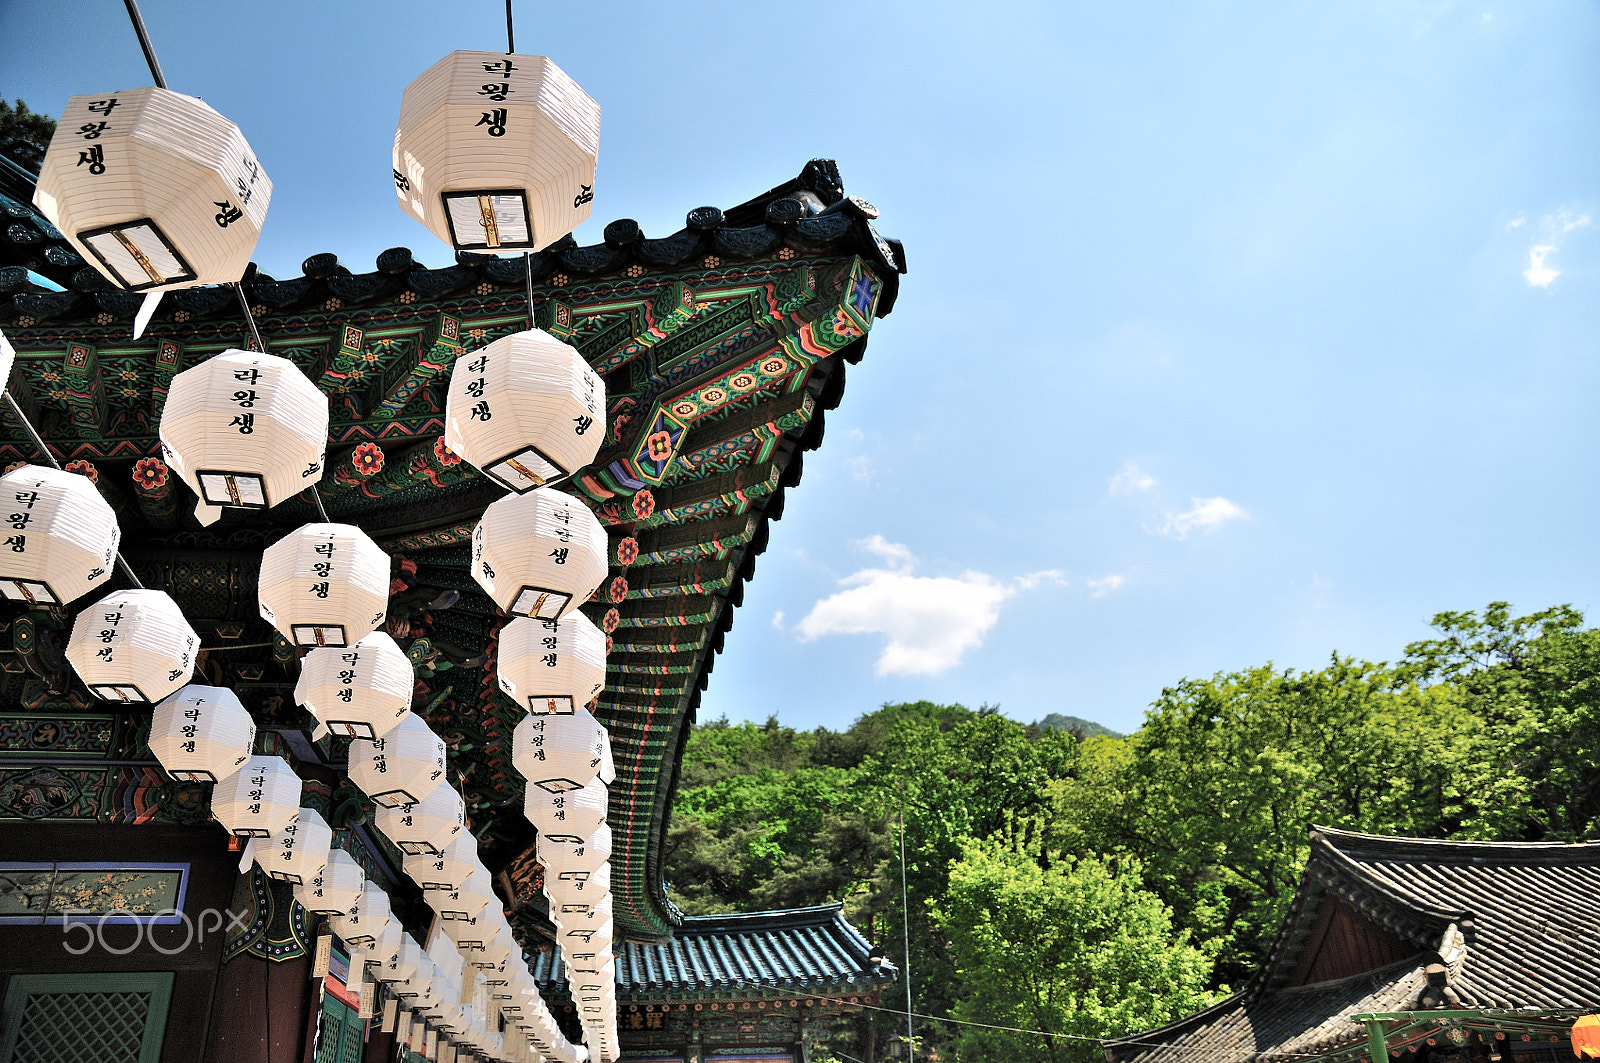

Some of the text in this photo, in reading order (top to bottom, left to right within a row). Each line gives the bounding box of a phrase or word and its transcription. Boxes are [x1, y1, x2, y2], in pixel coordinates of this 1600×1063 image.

[474, 59, 518, 137] 락왕생
[77, 98, 122, 175] 락왕생
[228, 360, 263, 435] 락왕생
[464, 346, 491, 422] 락왕생
[3, 481, 41, 553] 락왕생
[309, 532, 337, 599] 락왕생
[336, 641, 362, 703] 락왕생
